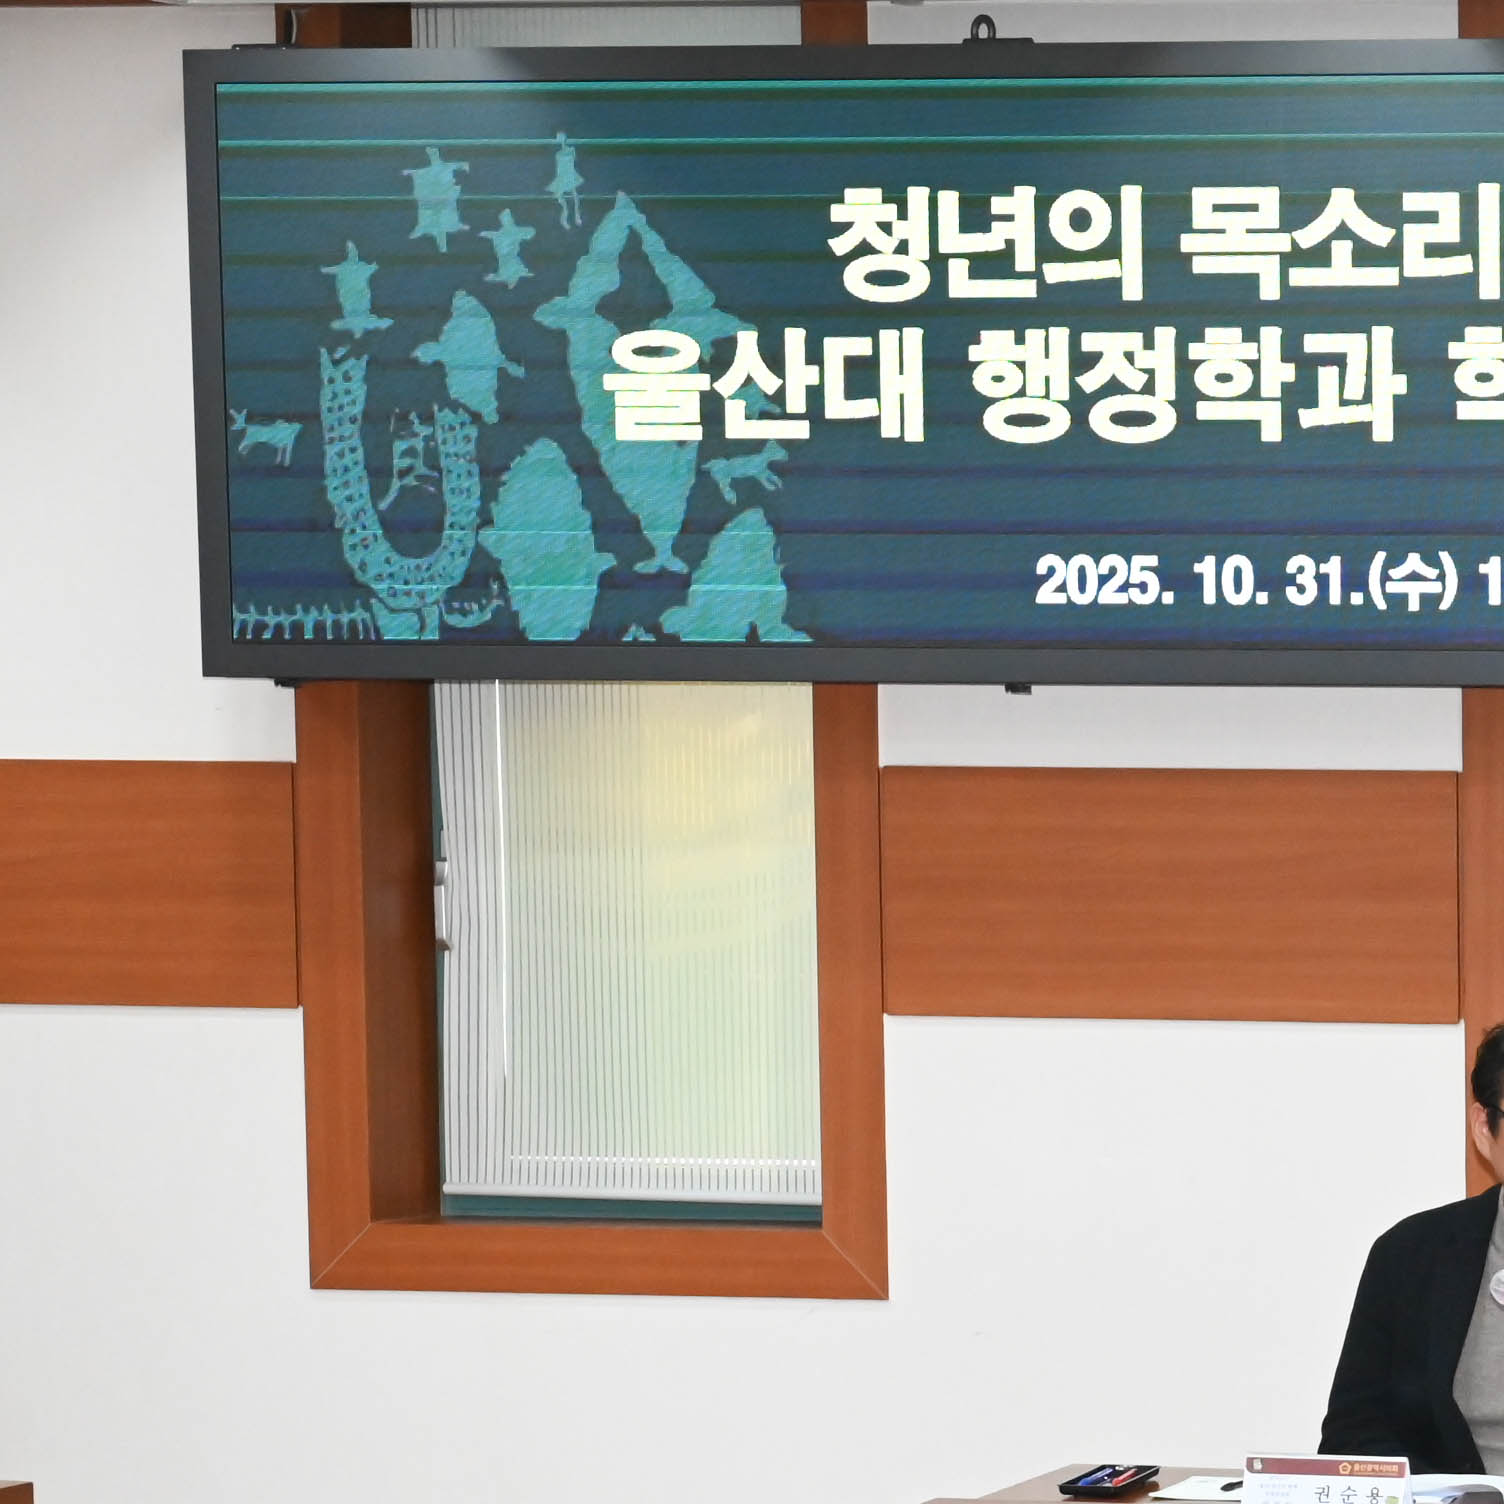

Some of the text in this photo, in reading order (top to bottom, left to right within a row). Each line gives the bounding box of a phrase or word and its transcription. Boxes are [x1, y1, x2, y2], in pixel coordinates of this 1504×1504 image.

[828, 185, 1143, 302] 청년의
[603, 328, 924, 442] 울산대
[969, 326, 1407, 443] 행정학과
[1036, 554, 1173, 605] 2025.
[1194, 555, 1268, 605] 10.
[1286, 551, 1458, 611] 31.(수)
